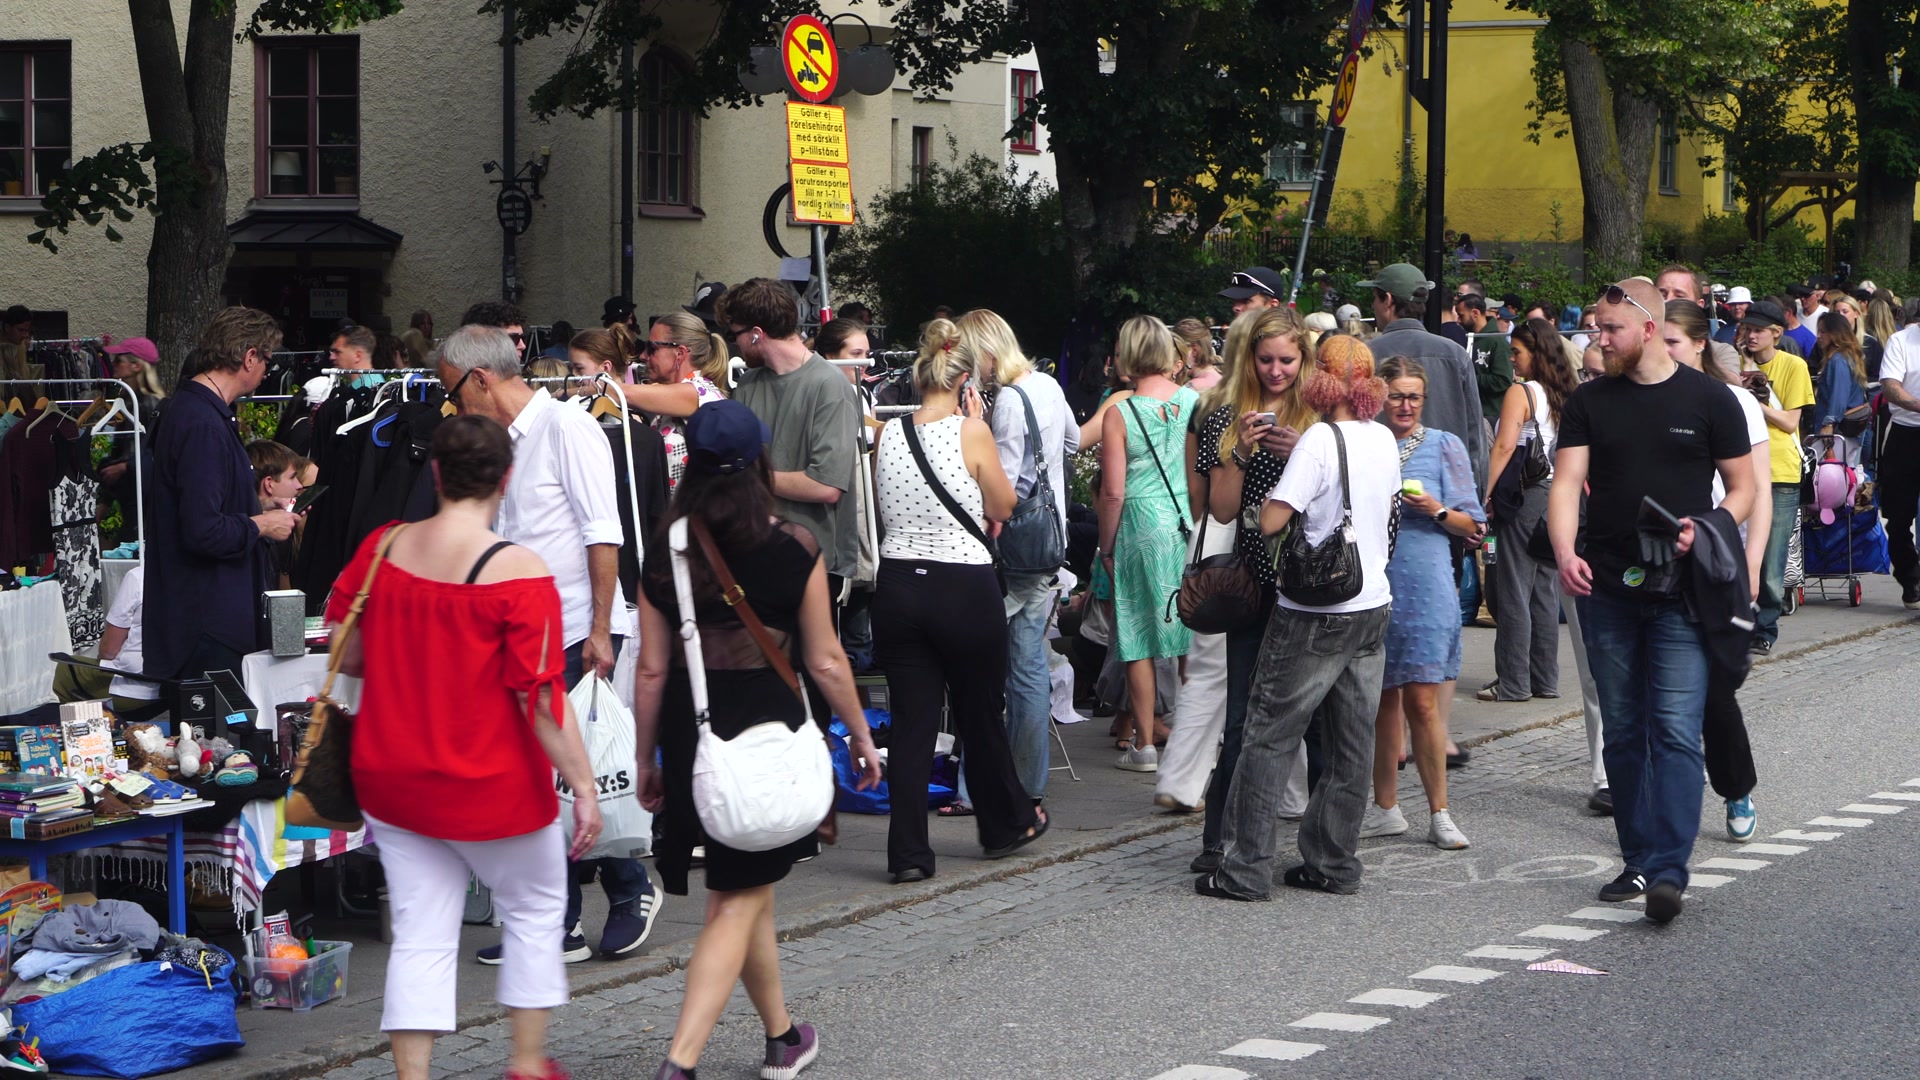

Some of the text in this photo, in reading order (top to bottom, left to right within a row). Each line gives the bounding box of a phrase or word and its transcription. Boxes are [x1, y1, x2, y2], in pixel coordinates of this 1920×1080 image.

[801, 108, 831, 120] Gäller ej
[790, 120, 843, 132] rörelsehindrad
[796, 133, 811, 142] med
[800, 146, 839, 157] p-tillstånd
[806, 166, 836, 178] Gäller ej
[795, 178, 849, 188] varutransporter
[805, 188, 815, 197] till
[816, 190, 823, 198] nr
[797, 200, 850, 212] nordlig riktning
[817, 210, 833, 219] 7-14
[555, 770, 630, 798] WY:S
